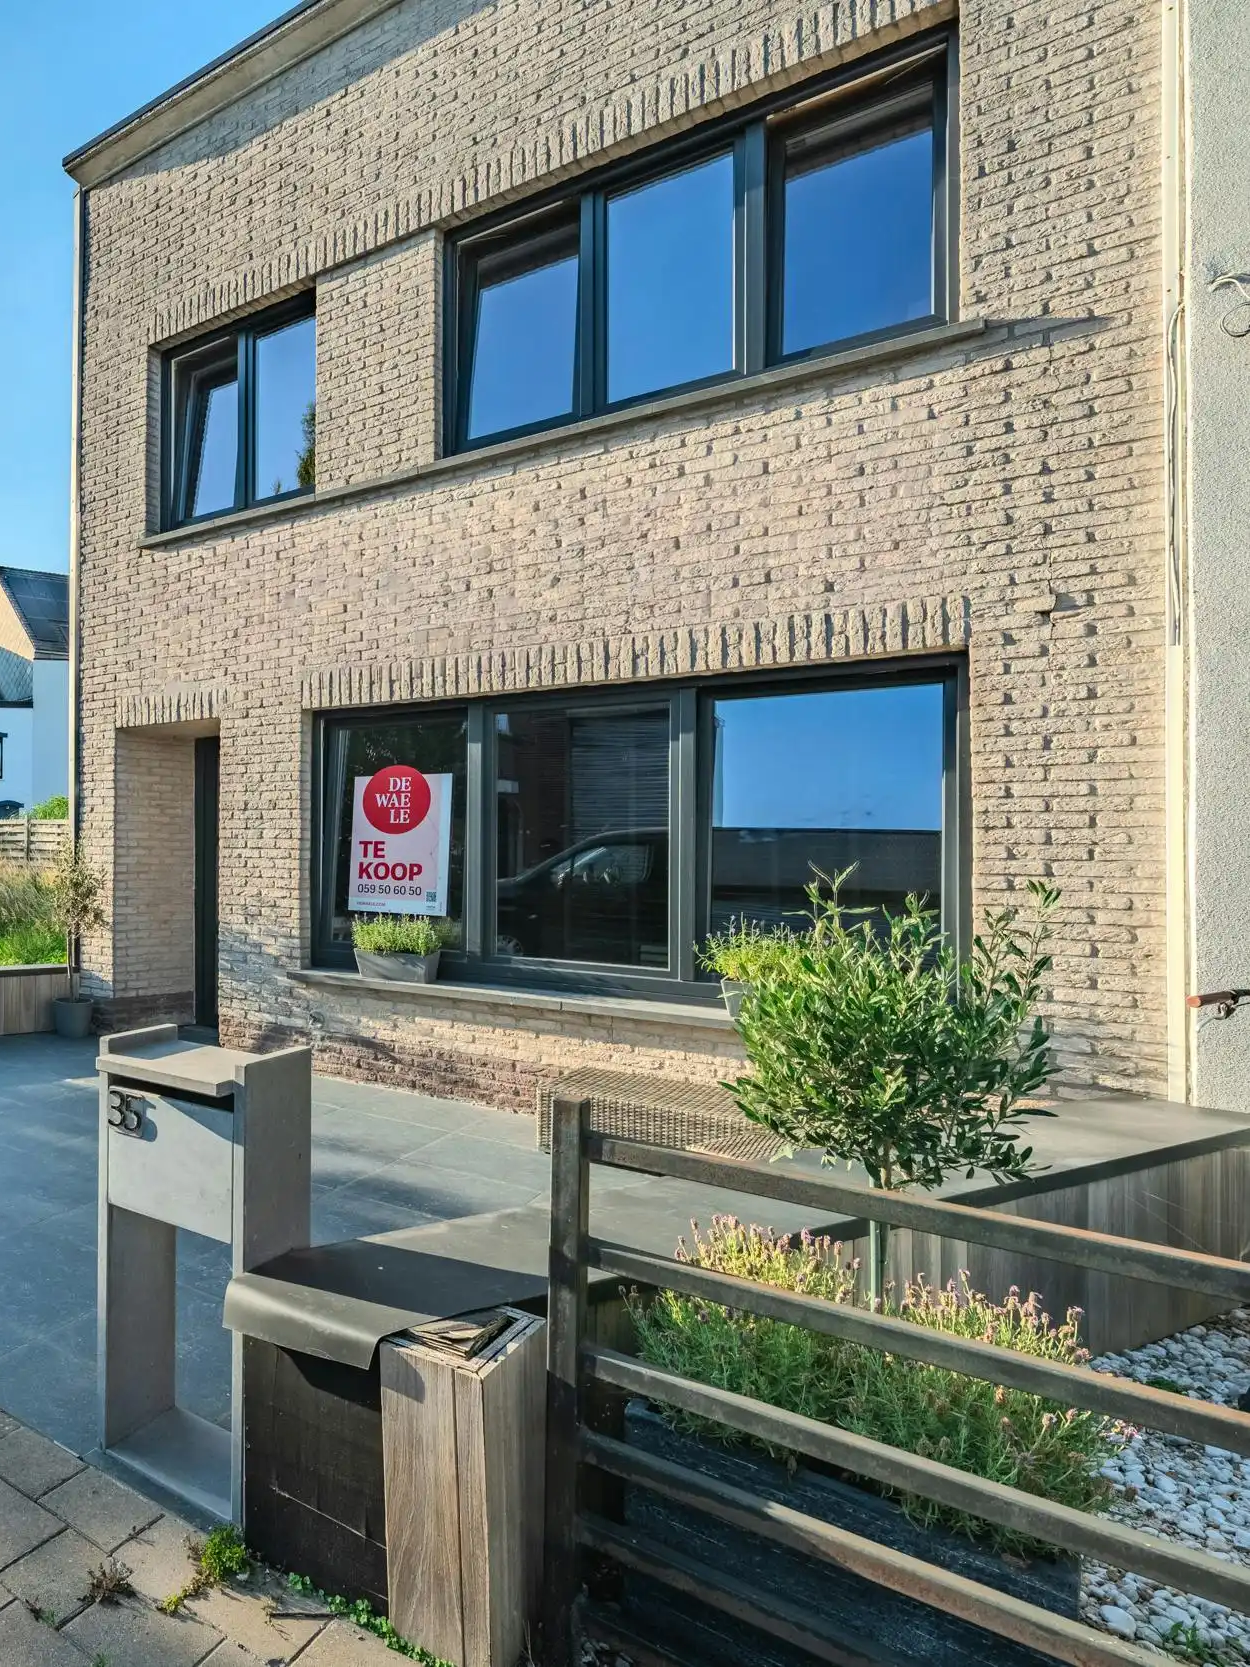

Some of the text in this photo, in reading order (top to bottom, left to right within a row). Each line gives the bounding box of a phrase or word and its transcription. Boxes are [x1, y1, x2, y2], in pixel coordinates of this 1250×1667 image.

[389, 777, 412, 792] DE
[375, 793, 411, 808] WAE
[389, 809, 410, 824] LE
[359, 840, 386, 859] TE
[358, 861, 423, 882] KOOP
[357, 883, 422, 896] 059 50 60 50
[108, 1090, 144, 1132] 35
